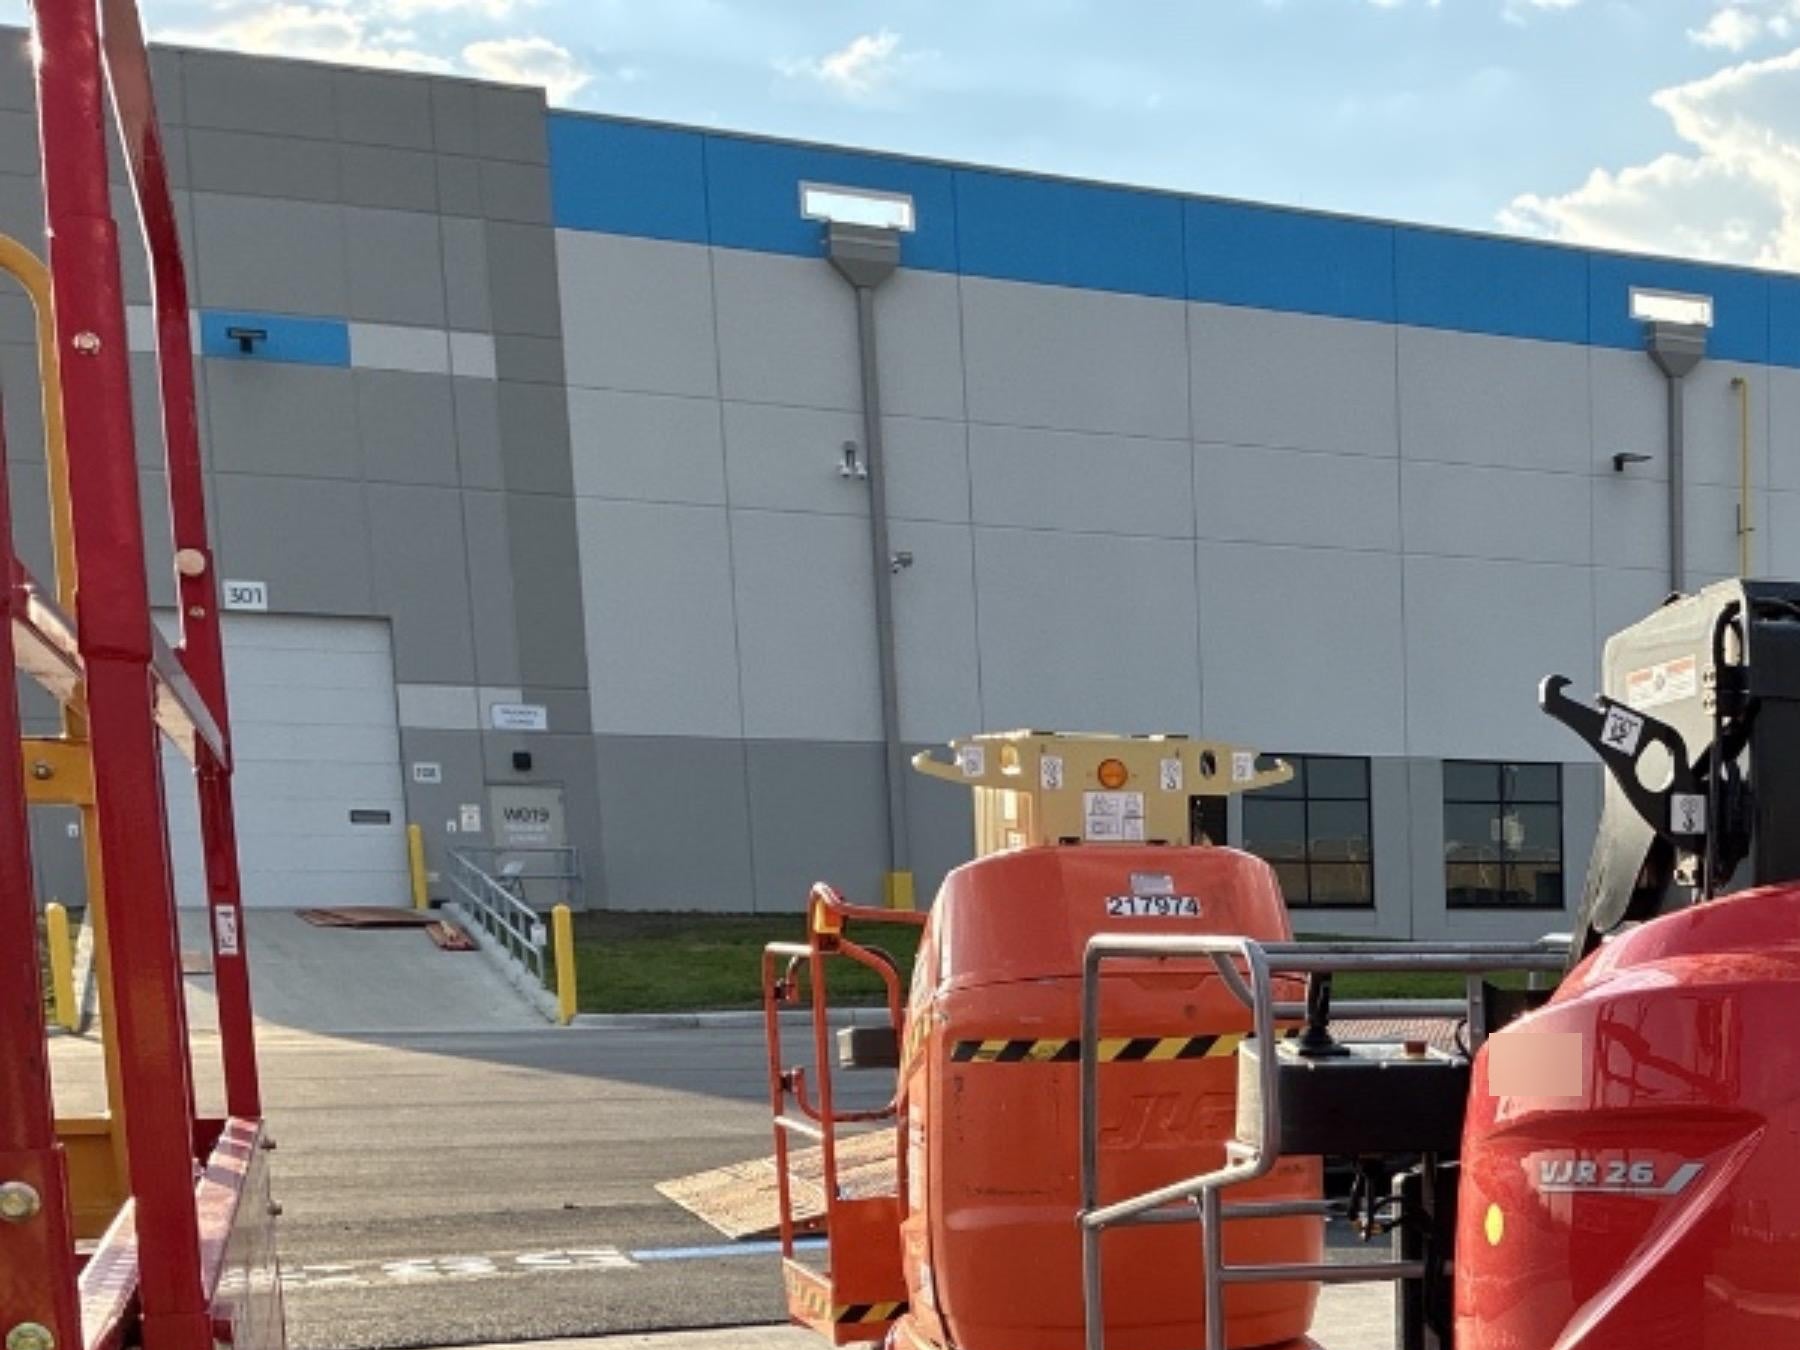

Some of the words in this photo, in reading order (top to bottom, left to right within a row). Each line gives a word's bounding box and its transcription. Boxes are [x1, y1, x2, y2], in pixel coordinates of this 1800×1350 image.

[1109, 896, 1199, 915] 217974
[1540, 1160, 1597, 1184] VJR
[1605, 1161, 1654, 1184] 26
